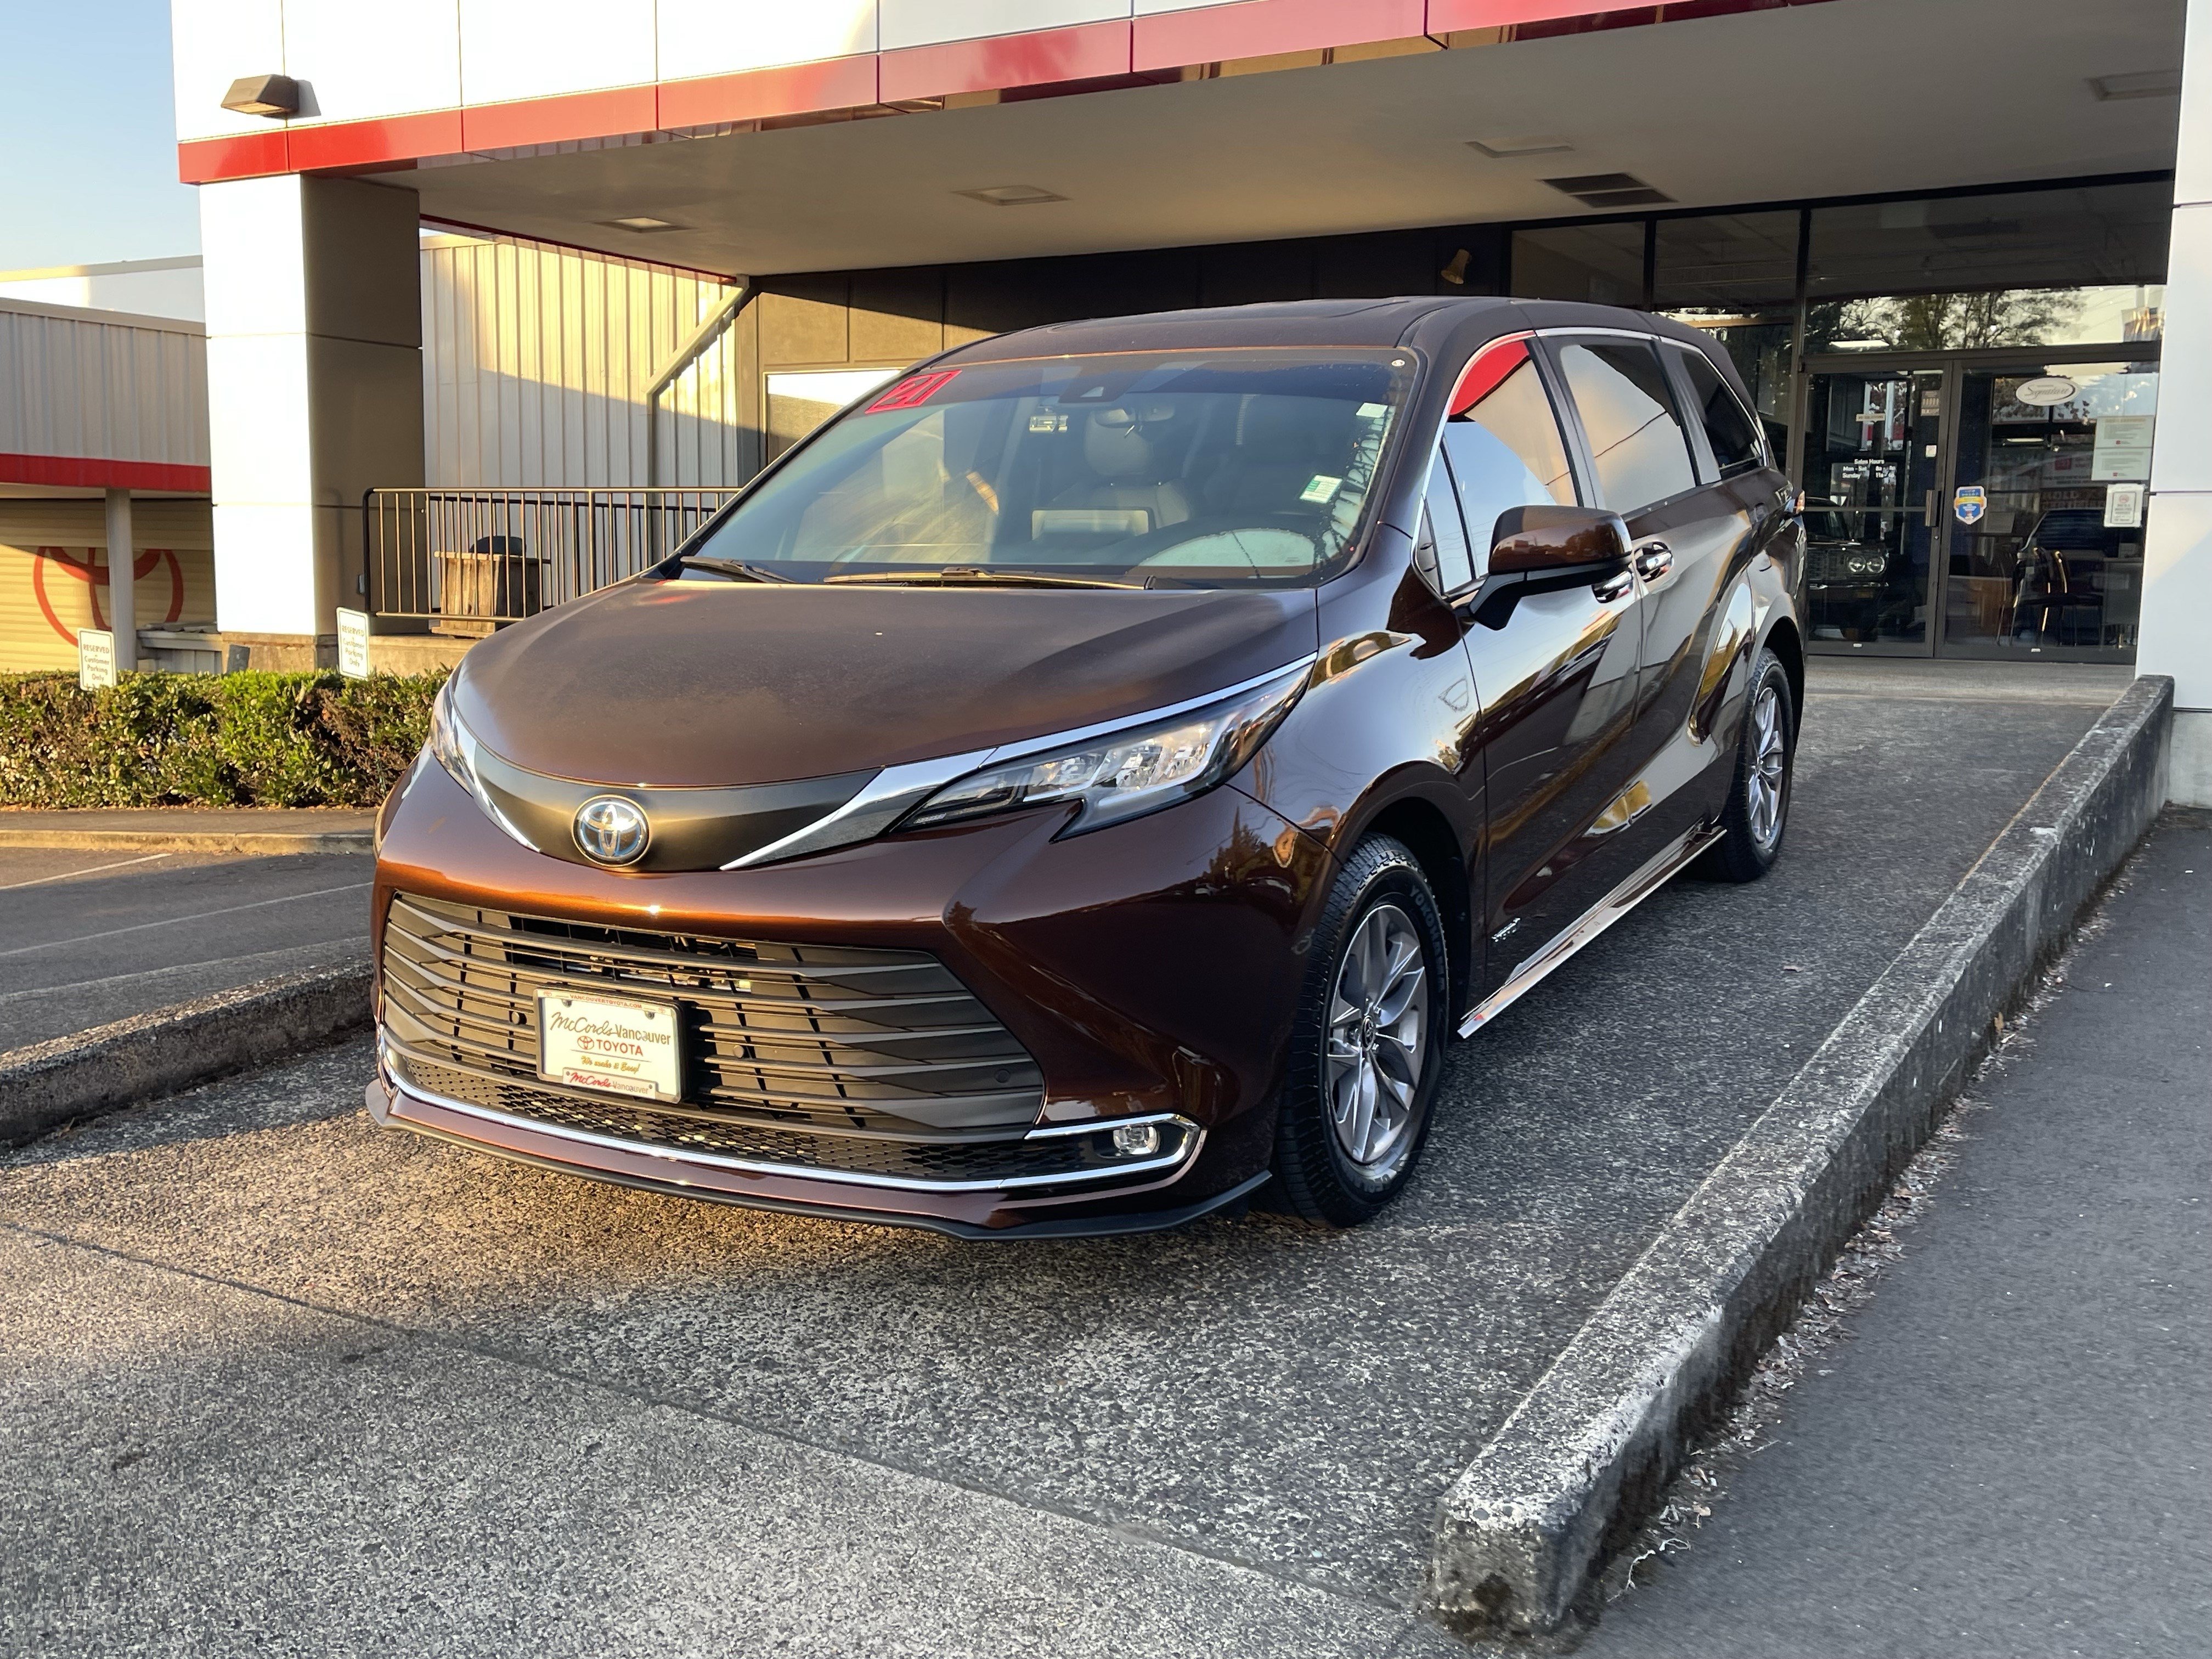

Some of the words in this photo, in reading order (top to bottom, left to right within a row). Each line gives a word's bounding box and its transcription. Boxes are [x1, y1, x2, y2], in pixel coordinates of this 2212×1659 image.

[342, 625, 365, 636] RESERVED
[343, 637, 364, 648] Customer
[83, 644, 109, 653] RESERVED
[345, 647, 363, 660] Parking
[84, 655, 109, 665] Customer
[349, 658, 360, 668] Only
[87, 664, 108, 675] Parking
[92, 673, 104, 682] Only
[1409, 884, 1445, 992] YOKOHAMA
[569, 994, 642, 1009] VANCOUVERTOYOTA.COM
[596, 1039, 644, 1057] TOYOTA
[594, 1059, 612, 1069] make
